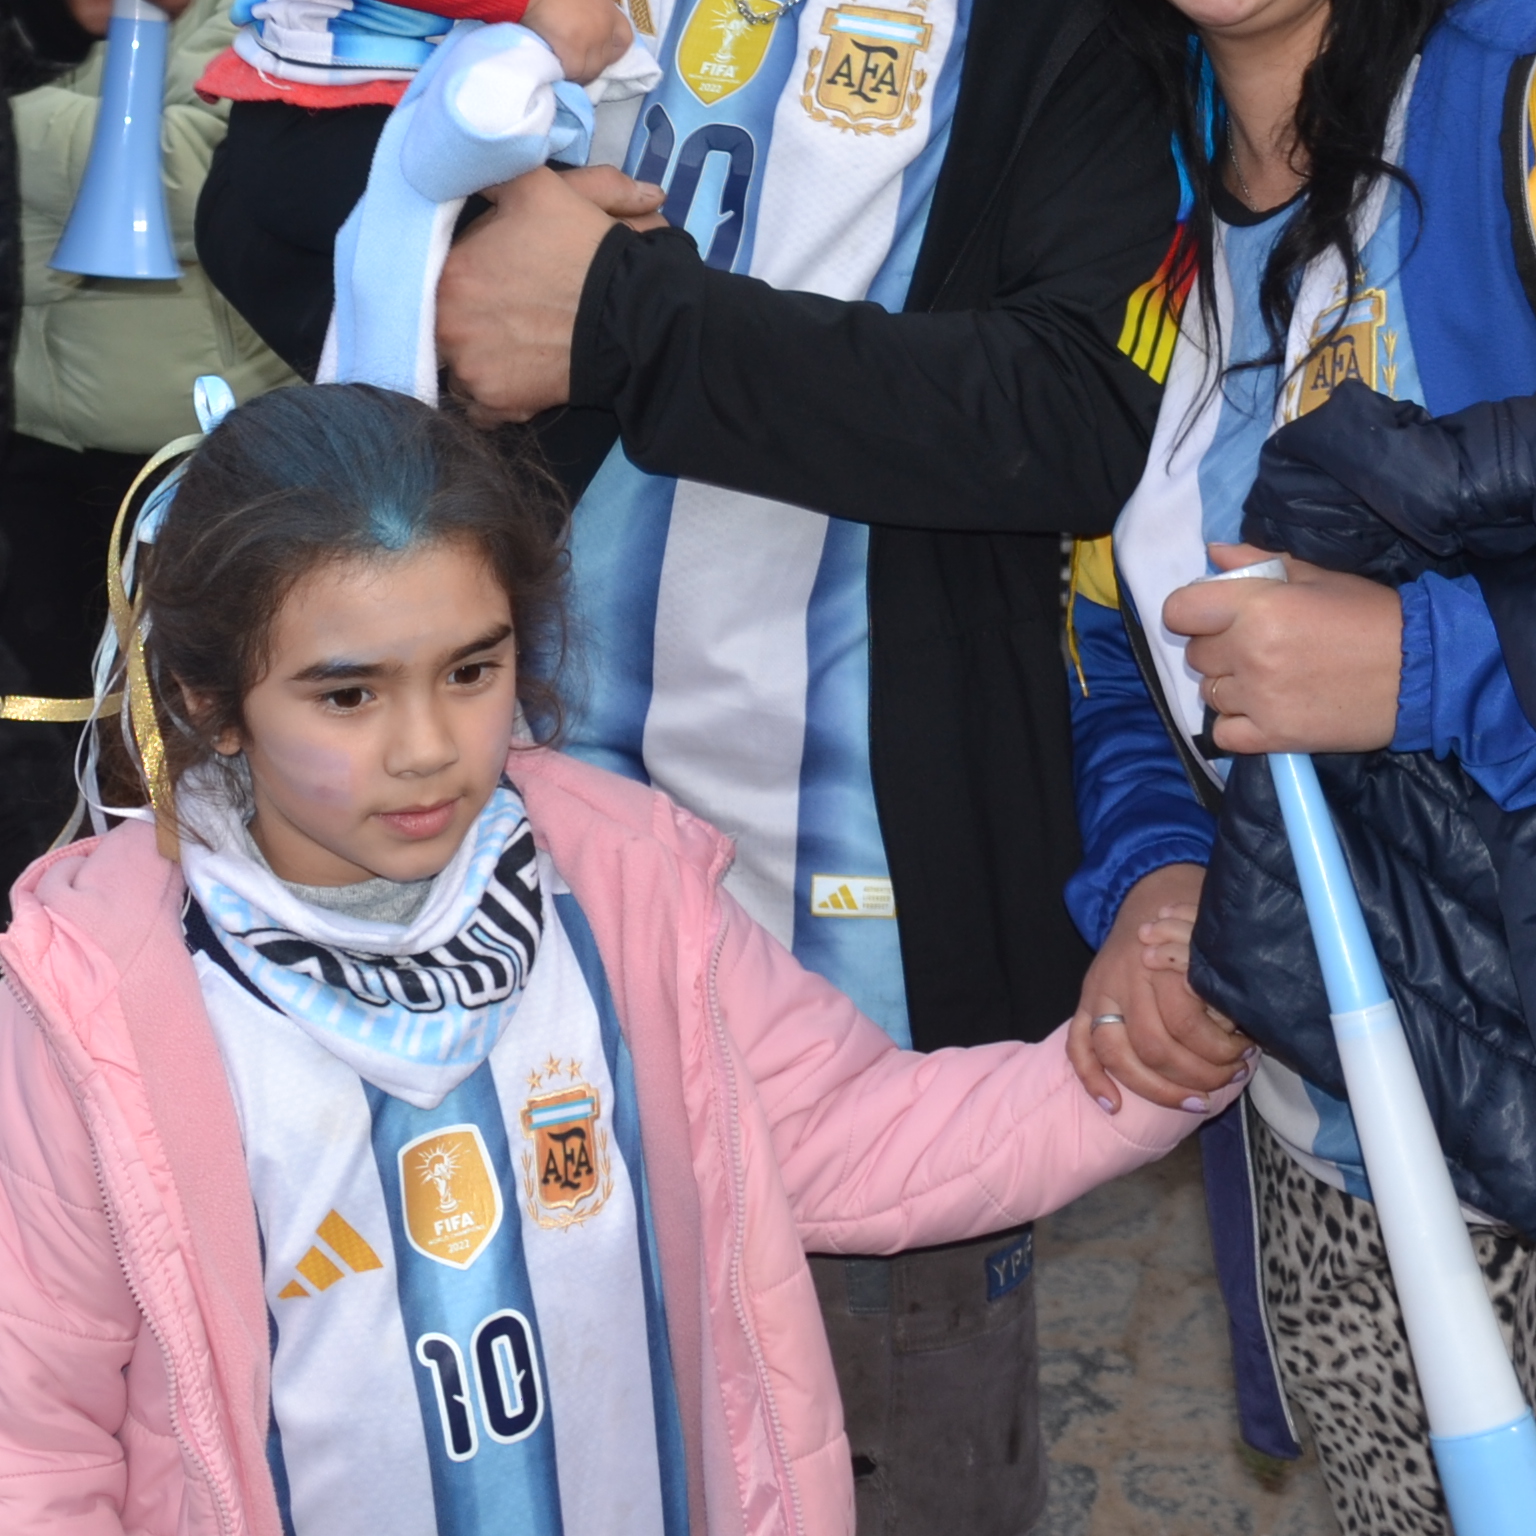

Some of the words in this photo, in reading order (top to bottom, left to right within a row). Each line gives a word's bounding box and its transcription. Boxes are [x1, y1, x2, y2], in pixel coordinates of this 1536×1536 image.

[698, 82, 723, 94] 2022
[700, 61, 736, 78] FIFA
[825, 38, 900, 104] AFA
[541, 1126, 594, 1191] AFA
[433, 1212, 475, 1236] FIFA
[415, 1308, 544, 1462] 10
